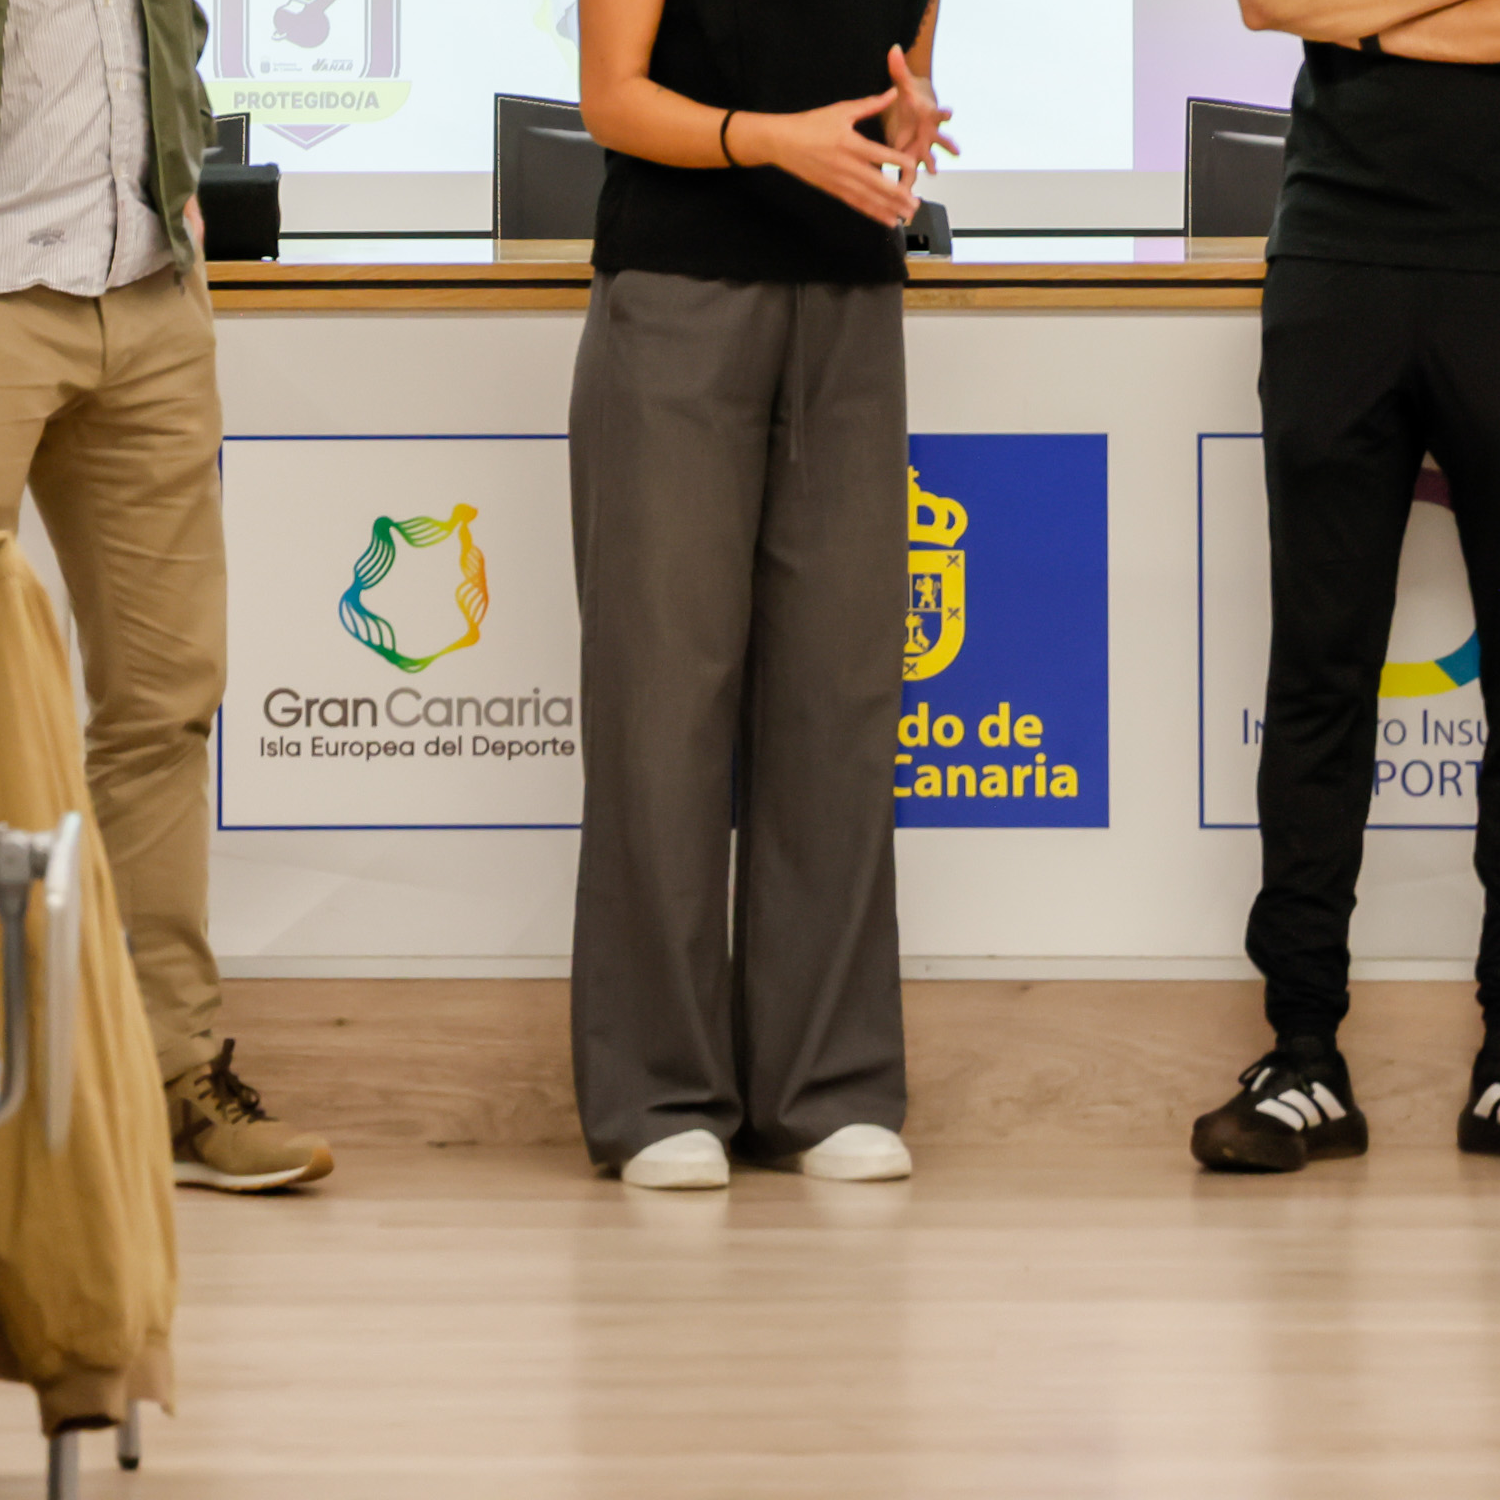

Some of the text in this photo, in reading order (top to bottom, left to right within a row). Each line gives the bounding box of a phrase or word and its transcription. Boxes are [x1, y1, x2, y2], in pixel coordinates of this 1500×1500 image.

[233, 90, 380, 111] PROTEGIDO/A
[978, 702, 1043, 747] de
[260, 736, 576, 761] Isla Europea del Deporte
